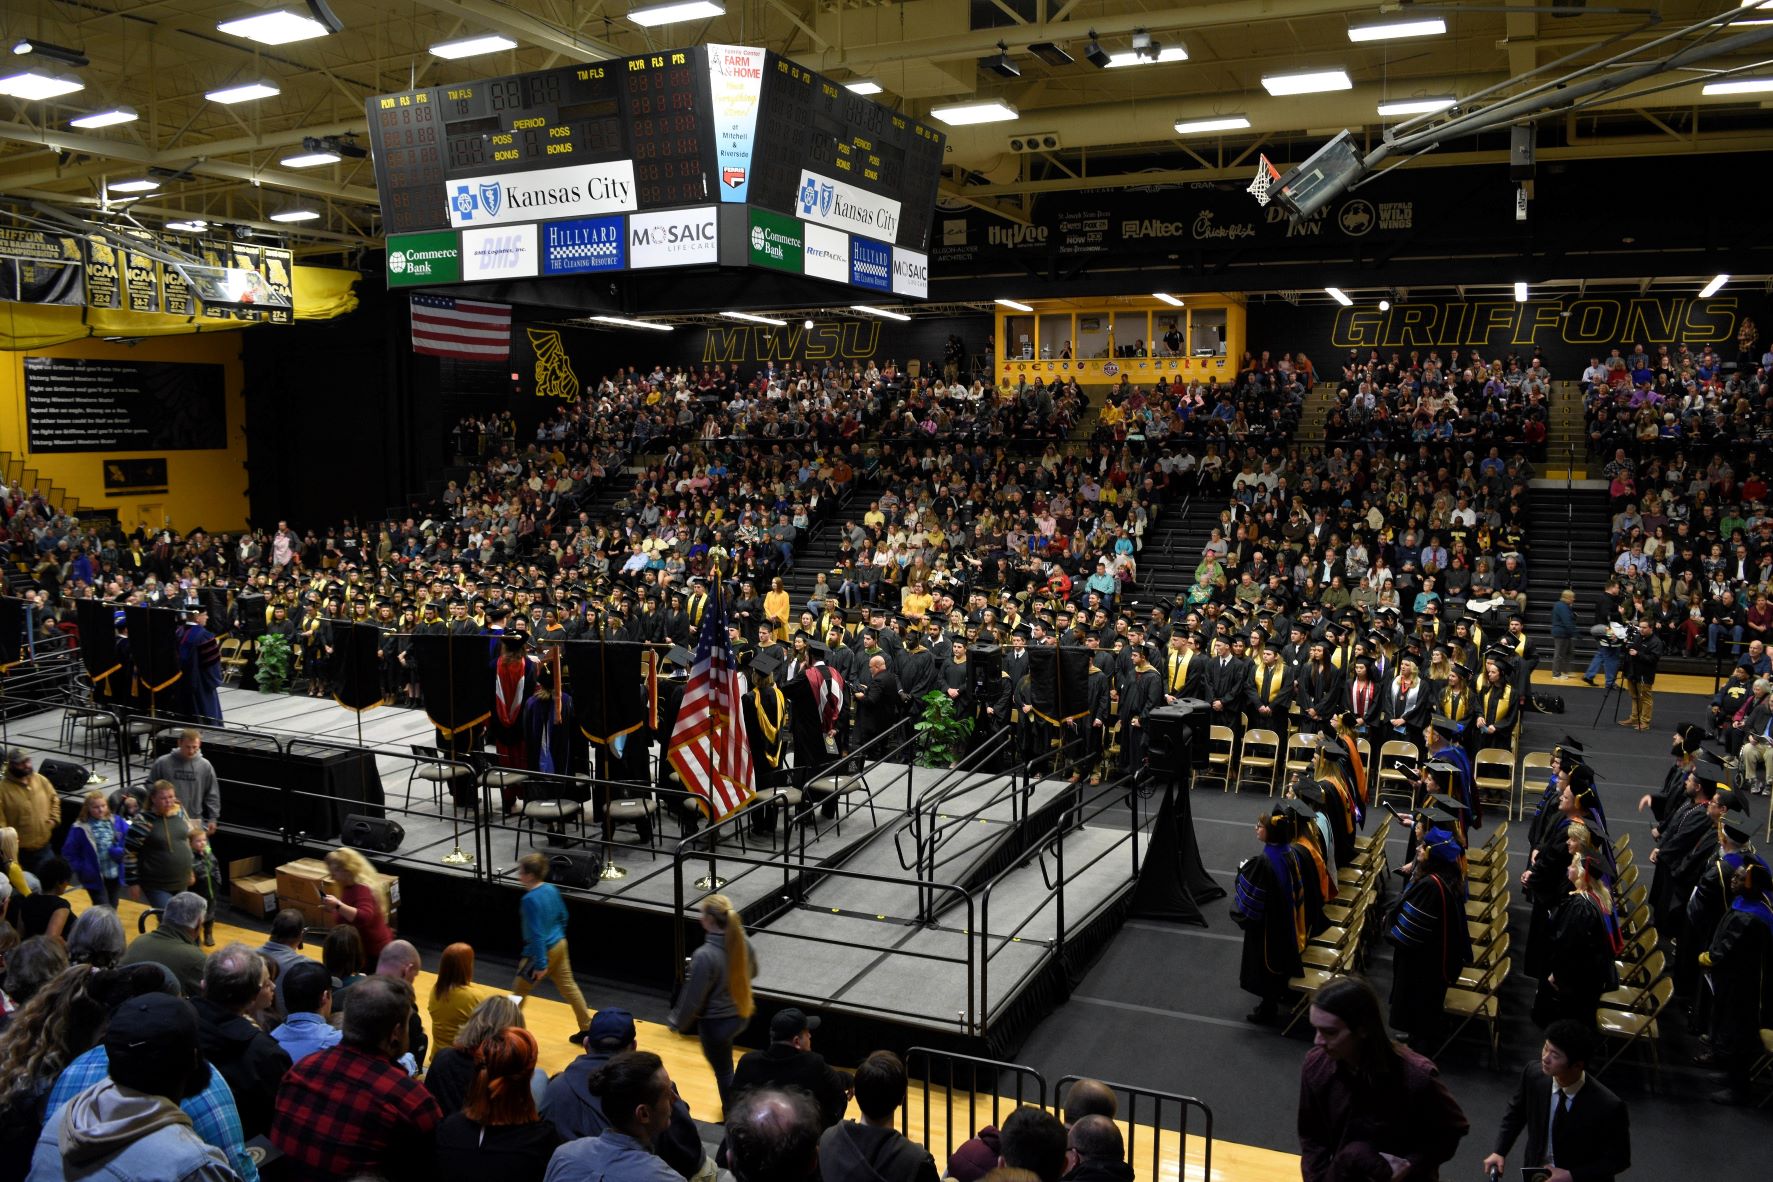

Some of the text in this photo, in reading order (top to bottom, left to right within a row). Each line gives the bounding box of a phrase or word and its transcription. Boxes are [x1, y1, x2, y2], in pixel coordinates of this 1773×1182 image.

[629, 53, 685, 71] PLYR FLS PTS
[724, 56, 750, 67] FARM
[577, 68, 604, 81] TM FLS
[733, 67, 761, 79] HOME
[380, 92, 427, 109] PLYR FLS PTS
[447, 88, 473, 100] TM FLS
[513, 117, 546, 130] PERIOD
[549, 126, 571, 138] POSS
[722, 132, 748, 140] Mitchell
[492, 134, 513, 145] POSS
[853, 136, 872, 151] PERIOD
[494, 149, 520, 161] BONUS
[546, 143, 573, 155] BONUS
[720, 150, 748, 158] Riverside
[837, 142, 851, 155] POSS
[835, 157, 852, 171] BONUS
[868, 154, 881, 167] POSS
[863, 168, 879, 181] BONUS
[505, 177, 632, 209] Kansas City
[1379, 201, 1414, 210] BUFFALO
[833, 194, 897, 236] Kansas City
[1379, 209, 1414, 221] WILD
[1140, 219, 1184, 238] Altec
[1286, 220, 1322, 238] INN
[1379, 219, 1414, 230] WINGS
[550, 226, 617, 246] HILLYARD
[632, 222, 715, 246] MOSAIC
[765, 227, 802, 248] Commerce
[1066, 236, 1086, 245] NOW
[479, 234, 523, 271] BMS
[667, 242, 715, 252] LIFE CARE
[765, 242, 784, 257] Bank
[406, 248, 458, 261] Commerce
[854, 242, 887, 266] HILLYARD
[406, 261, 432, 274] Bank
[551, 256, 618, 270] THE CLEANING RESOURCE
[86, 264, 119, 279] NCAA
[893, 260, 927, 281] MOSAIC
[1332, 297, 1738, 347] GRIFFONS
[703, 321, 882, 362] MWSU
